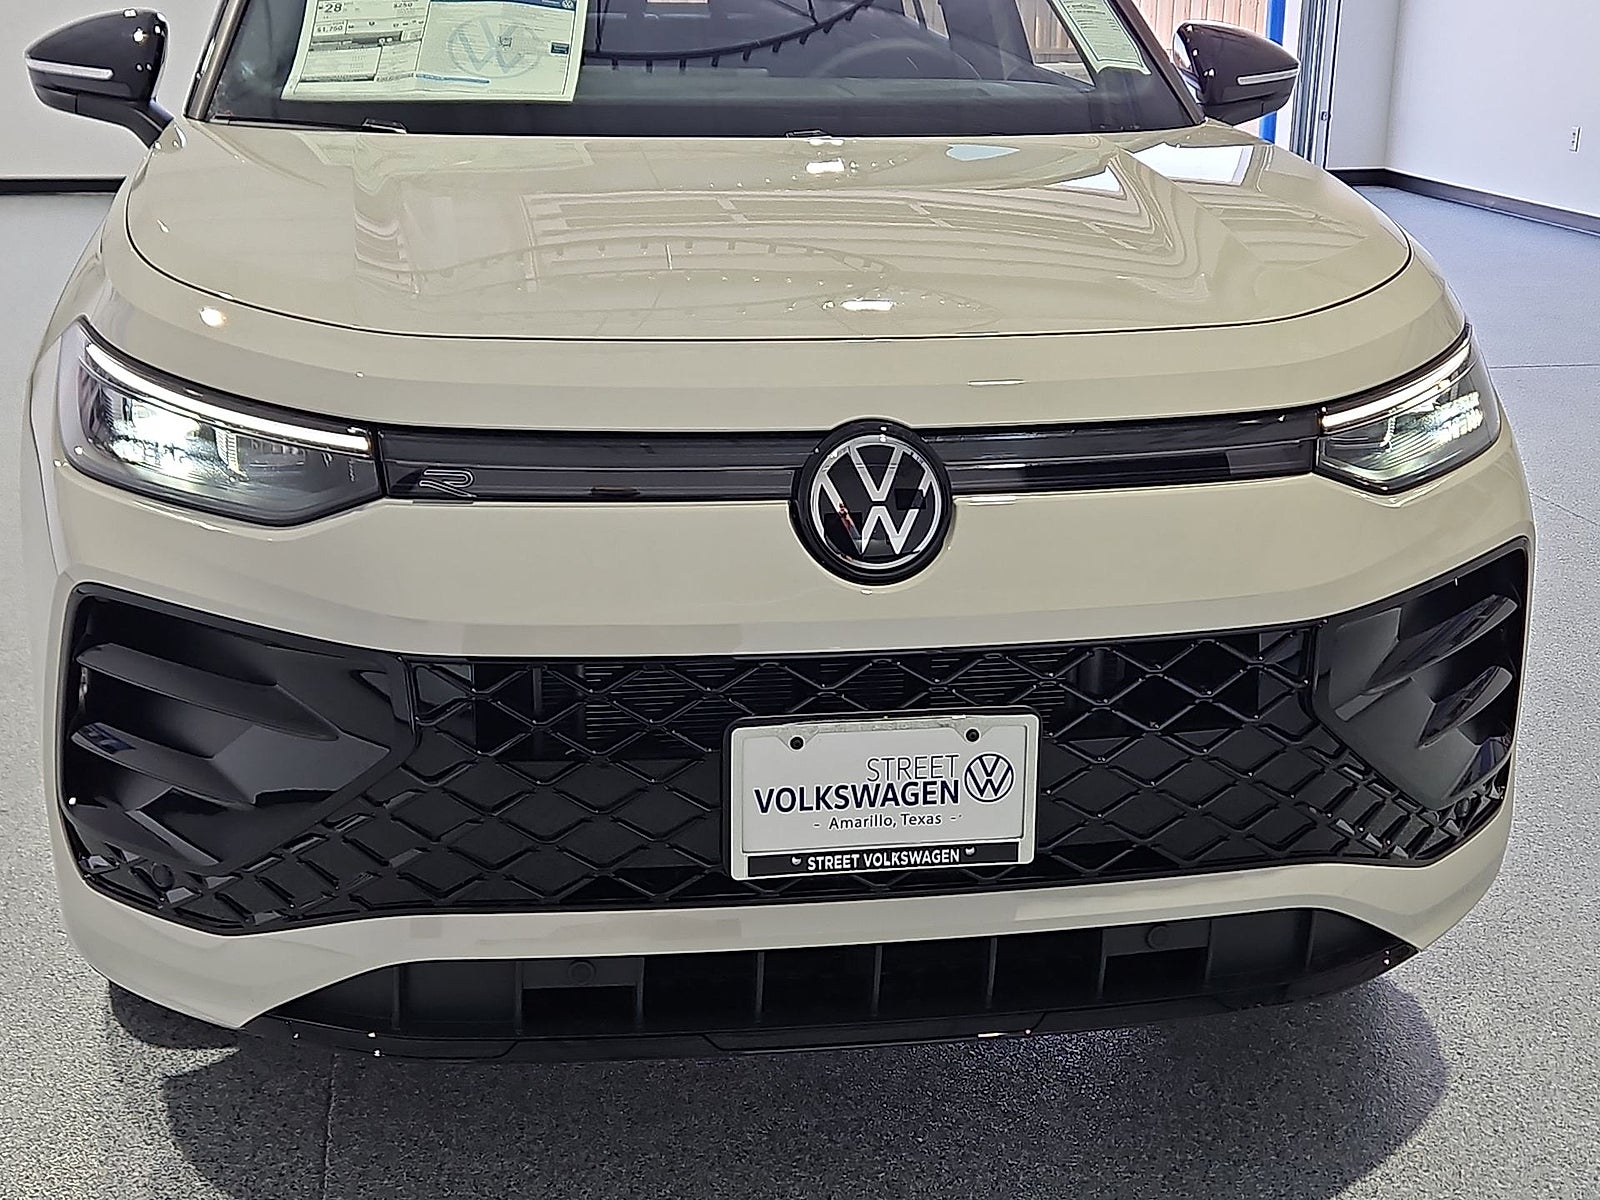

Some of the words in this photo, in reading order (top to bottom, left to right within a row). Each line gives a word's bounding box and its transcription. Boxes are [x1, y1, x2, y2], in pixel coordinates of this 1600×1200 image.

[867, 754, 960, 782] STREET
[754, 780, 960, 814] VOLKSWAGEN
[828, 815, 897, 830] Amarillo,
[900, 813, 942, 826] Texas
[807, 853, 862, 871] STREET
[863, 849, 960, 868] VOLKSWAGEN
